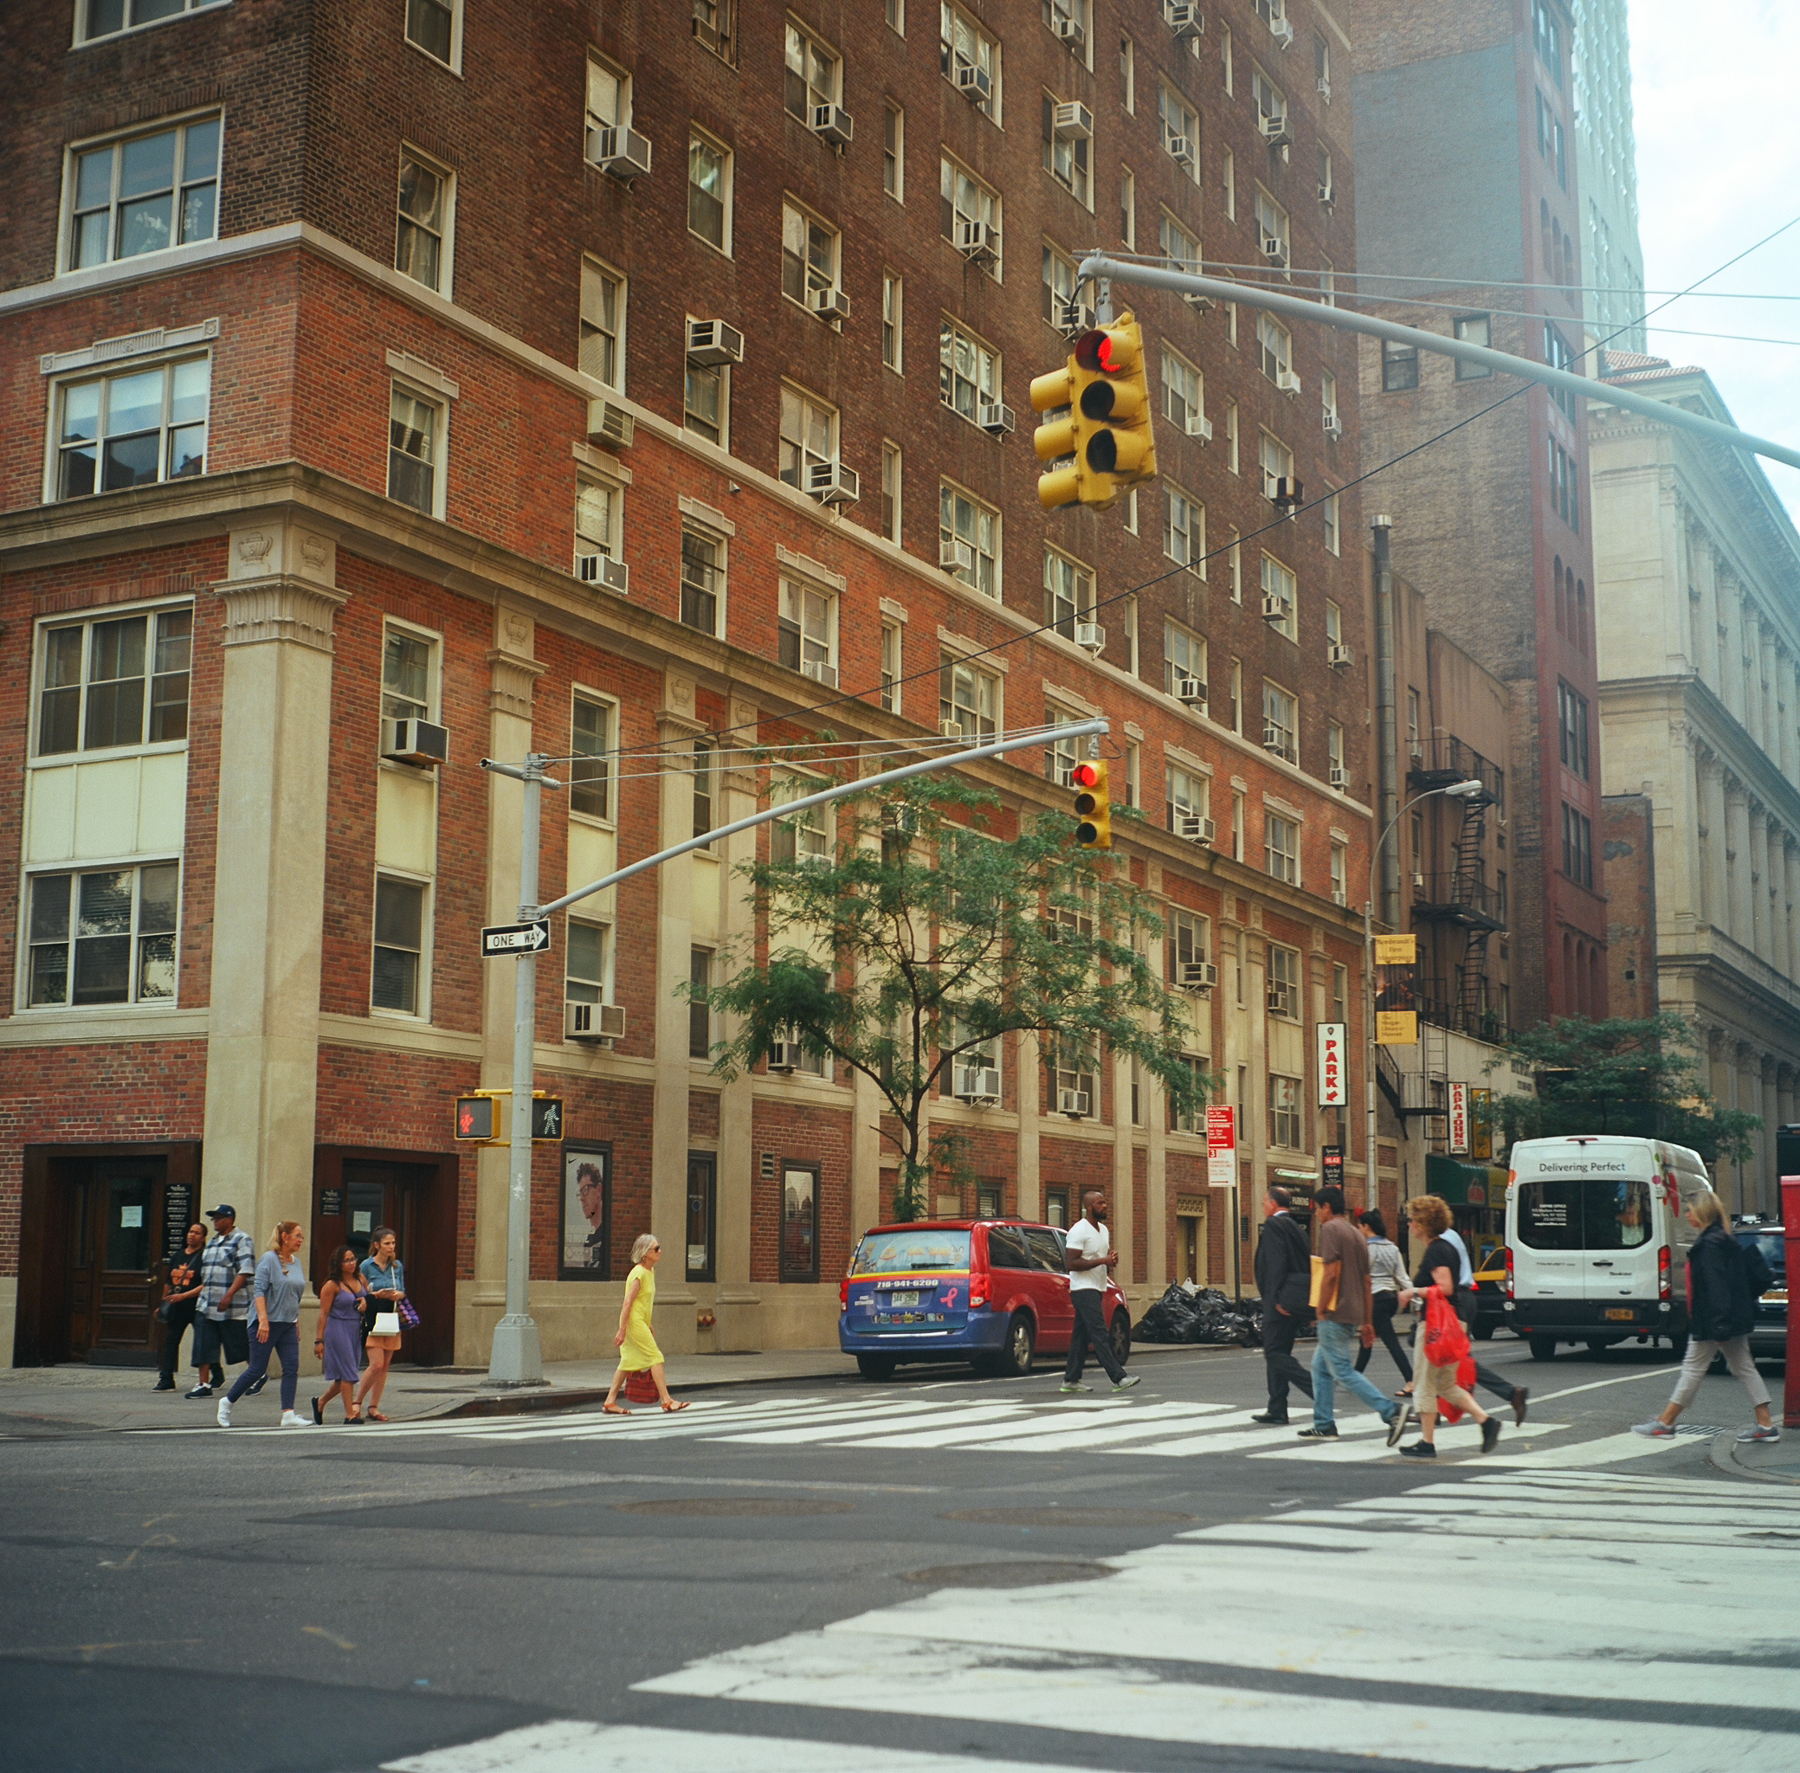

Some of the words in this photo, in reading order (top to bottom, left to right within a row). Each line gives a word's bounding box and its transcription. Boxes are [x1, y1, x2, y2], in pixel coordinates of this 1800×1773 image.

[493, 934, 514, 947] ONE
[523, 930, 541, 944] WAY
[1325, 1040, 1338, 1088] PARK
[1453, 1084, 1463, 1110] PAPA
[1540, 1162, 1588, 1173] Delivering
[1591, 1162, 1626, 1171] Perfect
[877, 1280, 938, 1288] 718-941-6200
